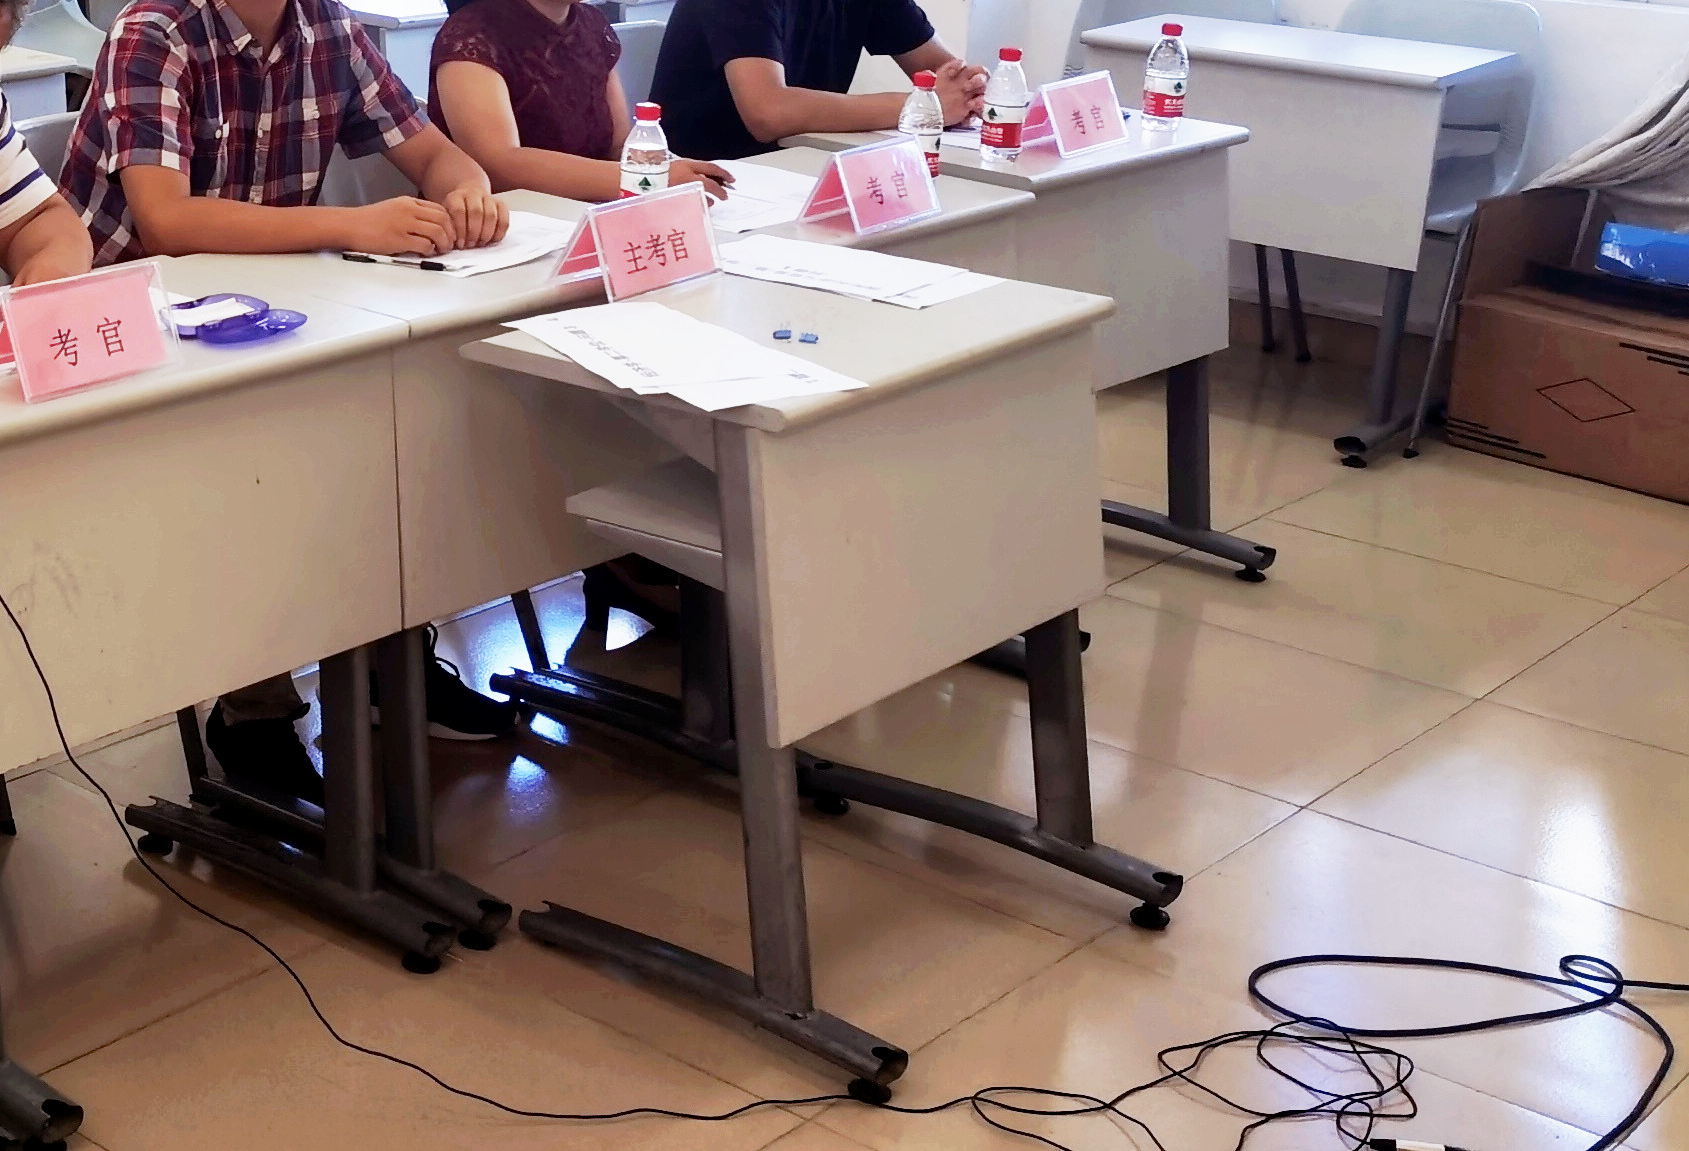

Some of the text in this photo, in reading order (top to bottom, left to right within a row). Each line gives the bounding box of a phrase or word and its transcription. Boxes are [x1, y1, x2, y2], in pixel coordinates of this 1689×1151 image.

[1070, 104, 1105, 136] 考官
[866, 170, 908, 205] 考官
[623, 229, 689, 275] 主考官
[48, 317, 125, 367] 考官
